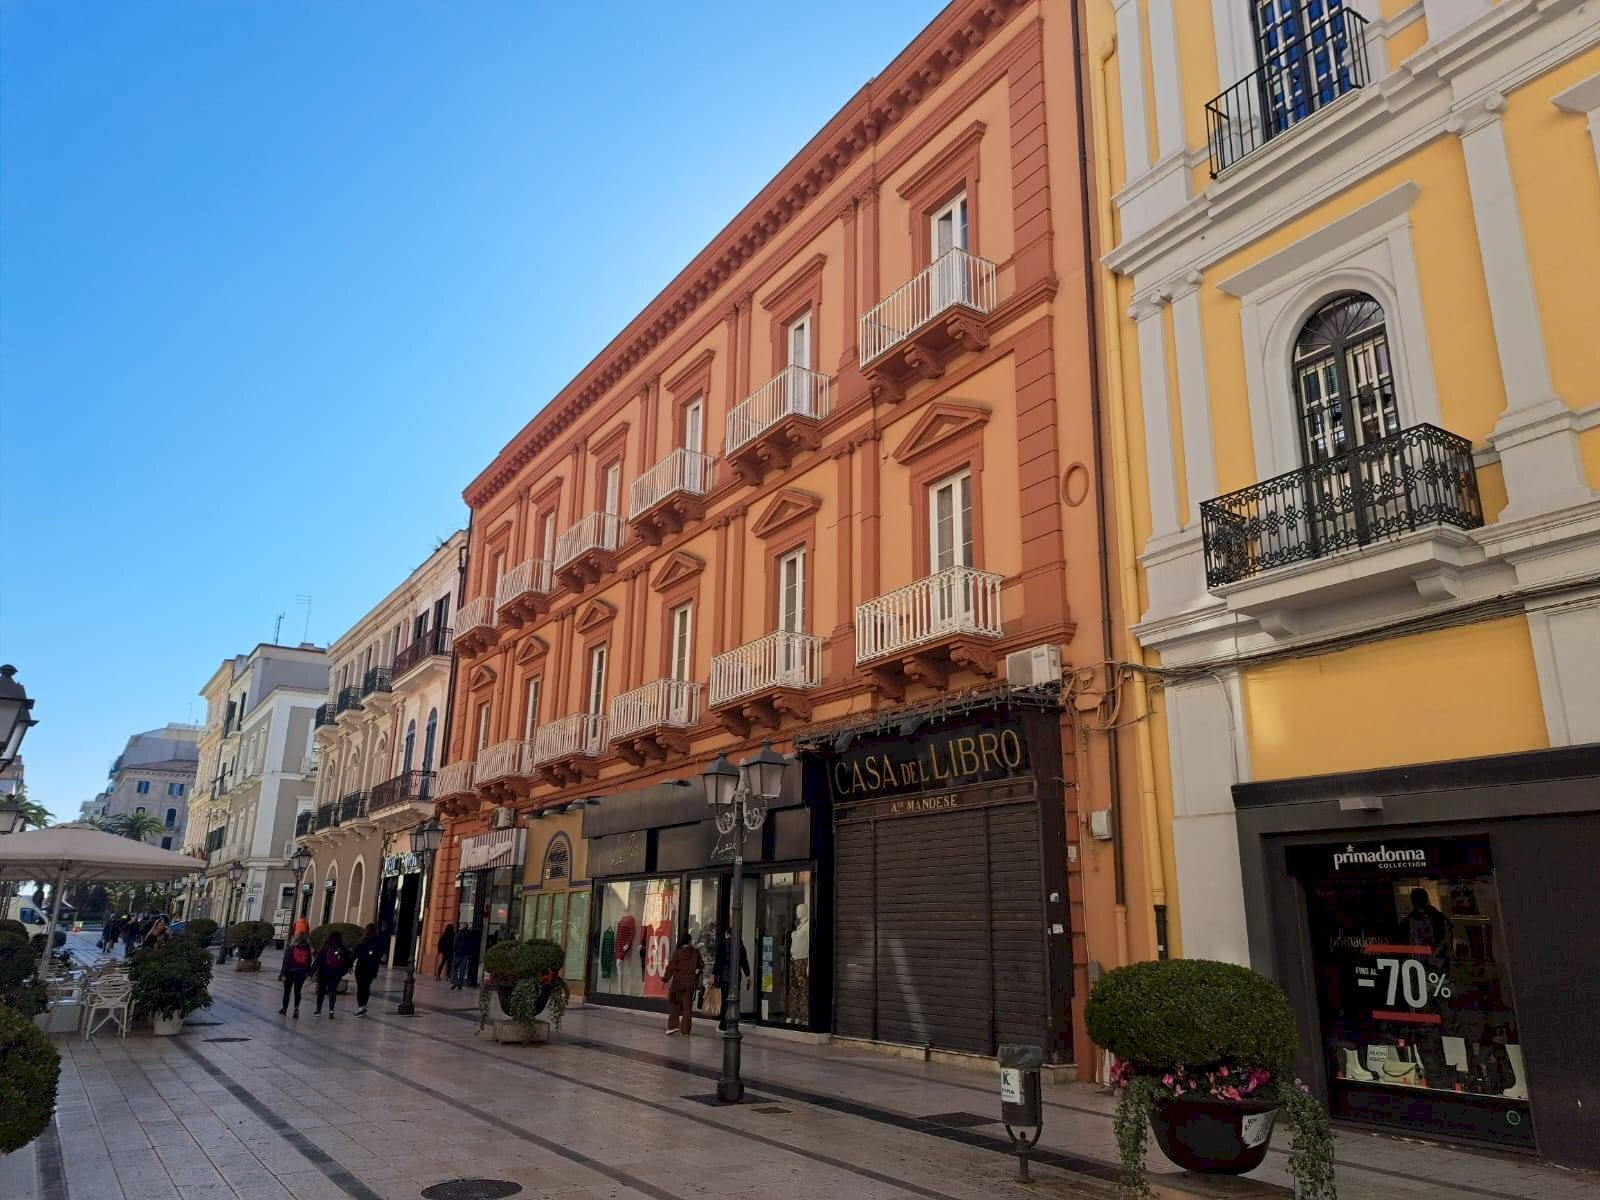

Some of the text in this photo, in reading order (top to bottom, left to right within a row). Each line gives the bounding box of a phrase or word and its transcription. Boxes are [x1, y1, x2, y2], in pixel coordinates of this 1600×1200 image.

[834, 729, 1021, 796] CASA DEL LIBRO
[906, 794, 957, 812] MANDESE
[1334, 844, 1425, 870] primadonna
[1378, 861, 1426, 869] COLLECTION
